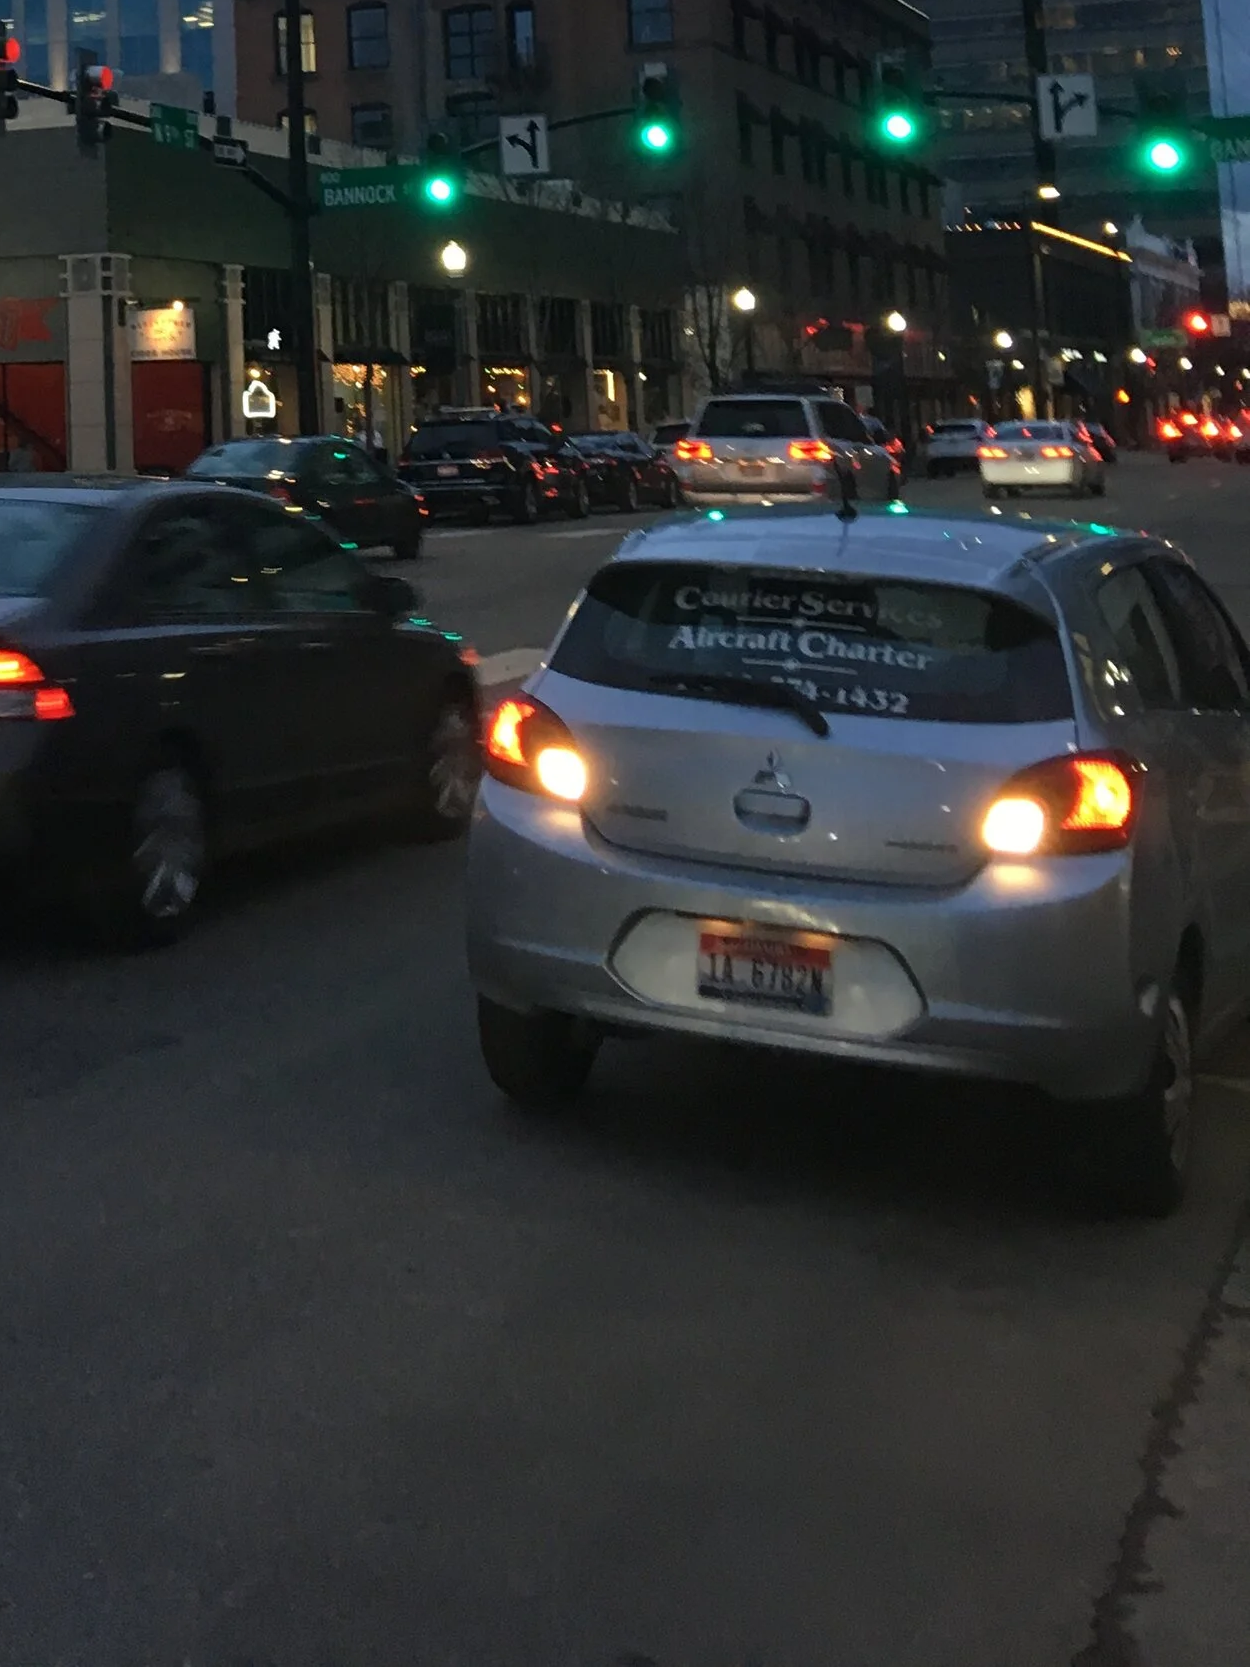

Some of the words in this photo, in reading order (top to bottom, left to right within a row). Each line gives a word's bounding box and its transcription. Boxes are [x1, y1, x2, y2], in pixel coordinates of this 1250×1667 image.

[323, 184, 396, 207] BANNOCK
[674, 586, 797, 612] Courier
[798, 590, 943, 629] Services
[668, 625, 792, 652] Aircraft
[798, 631, 934, 671] Charter
